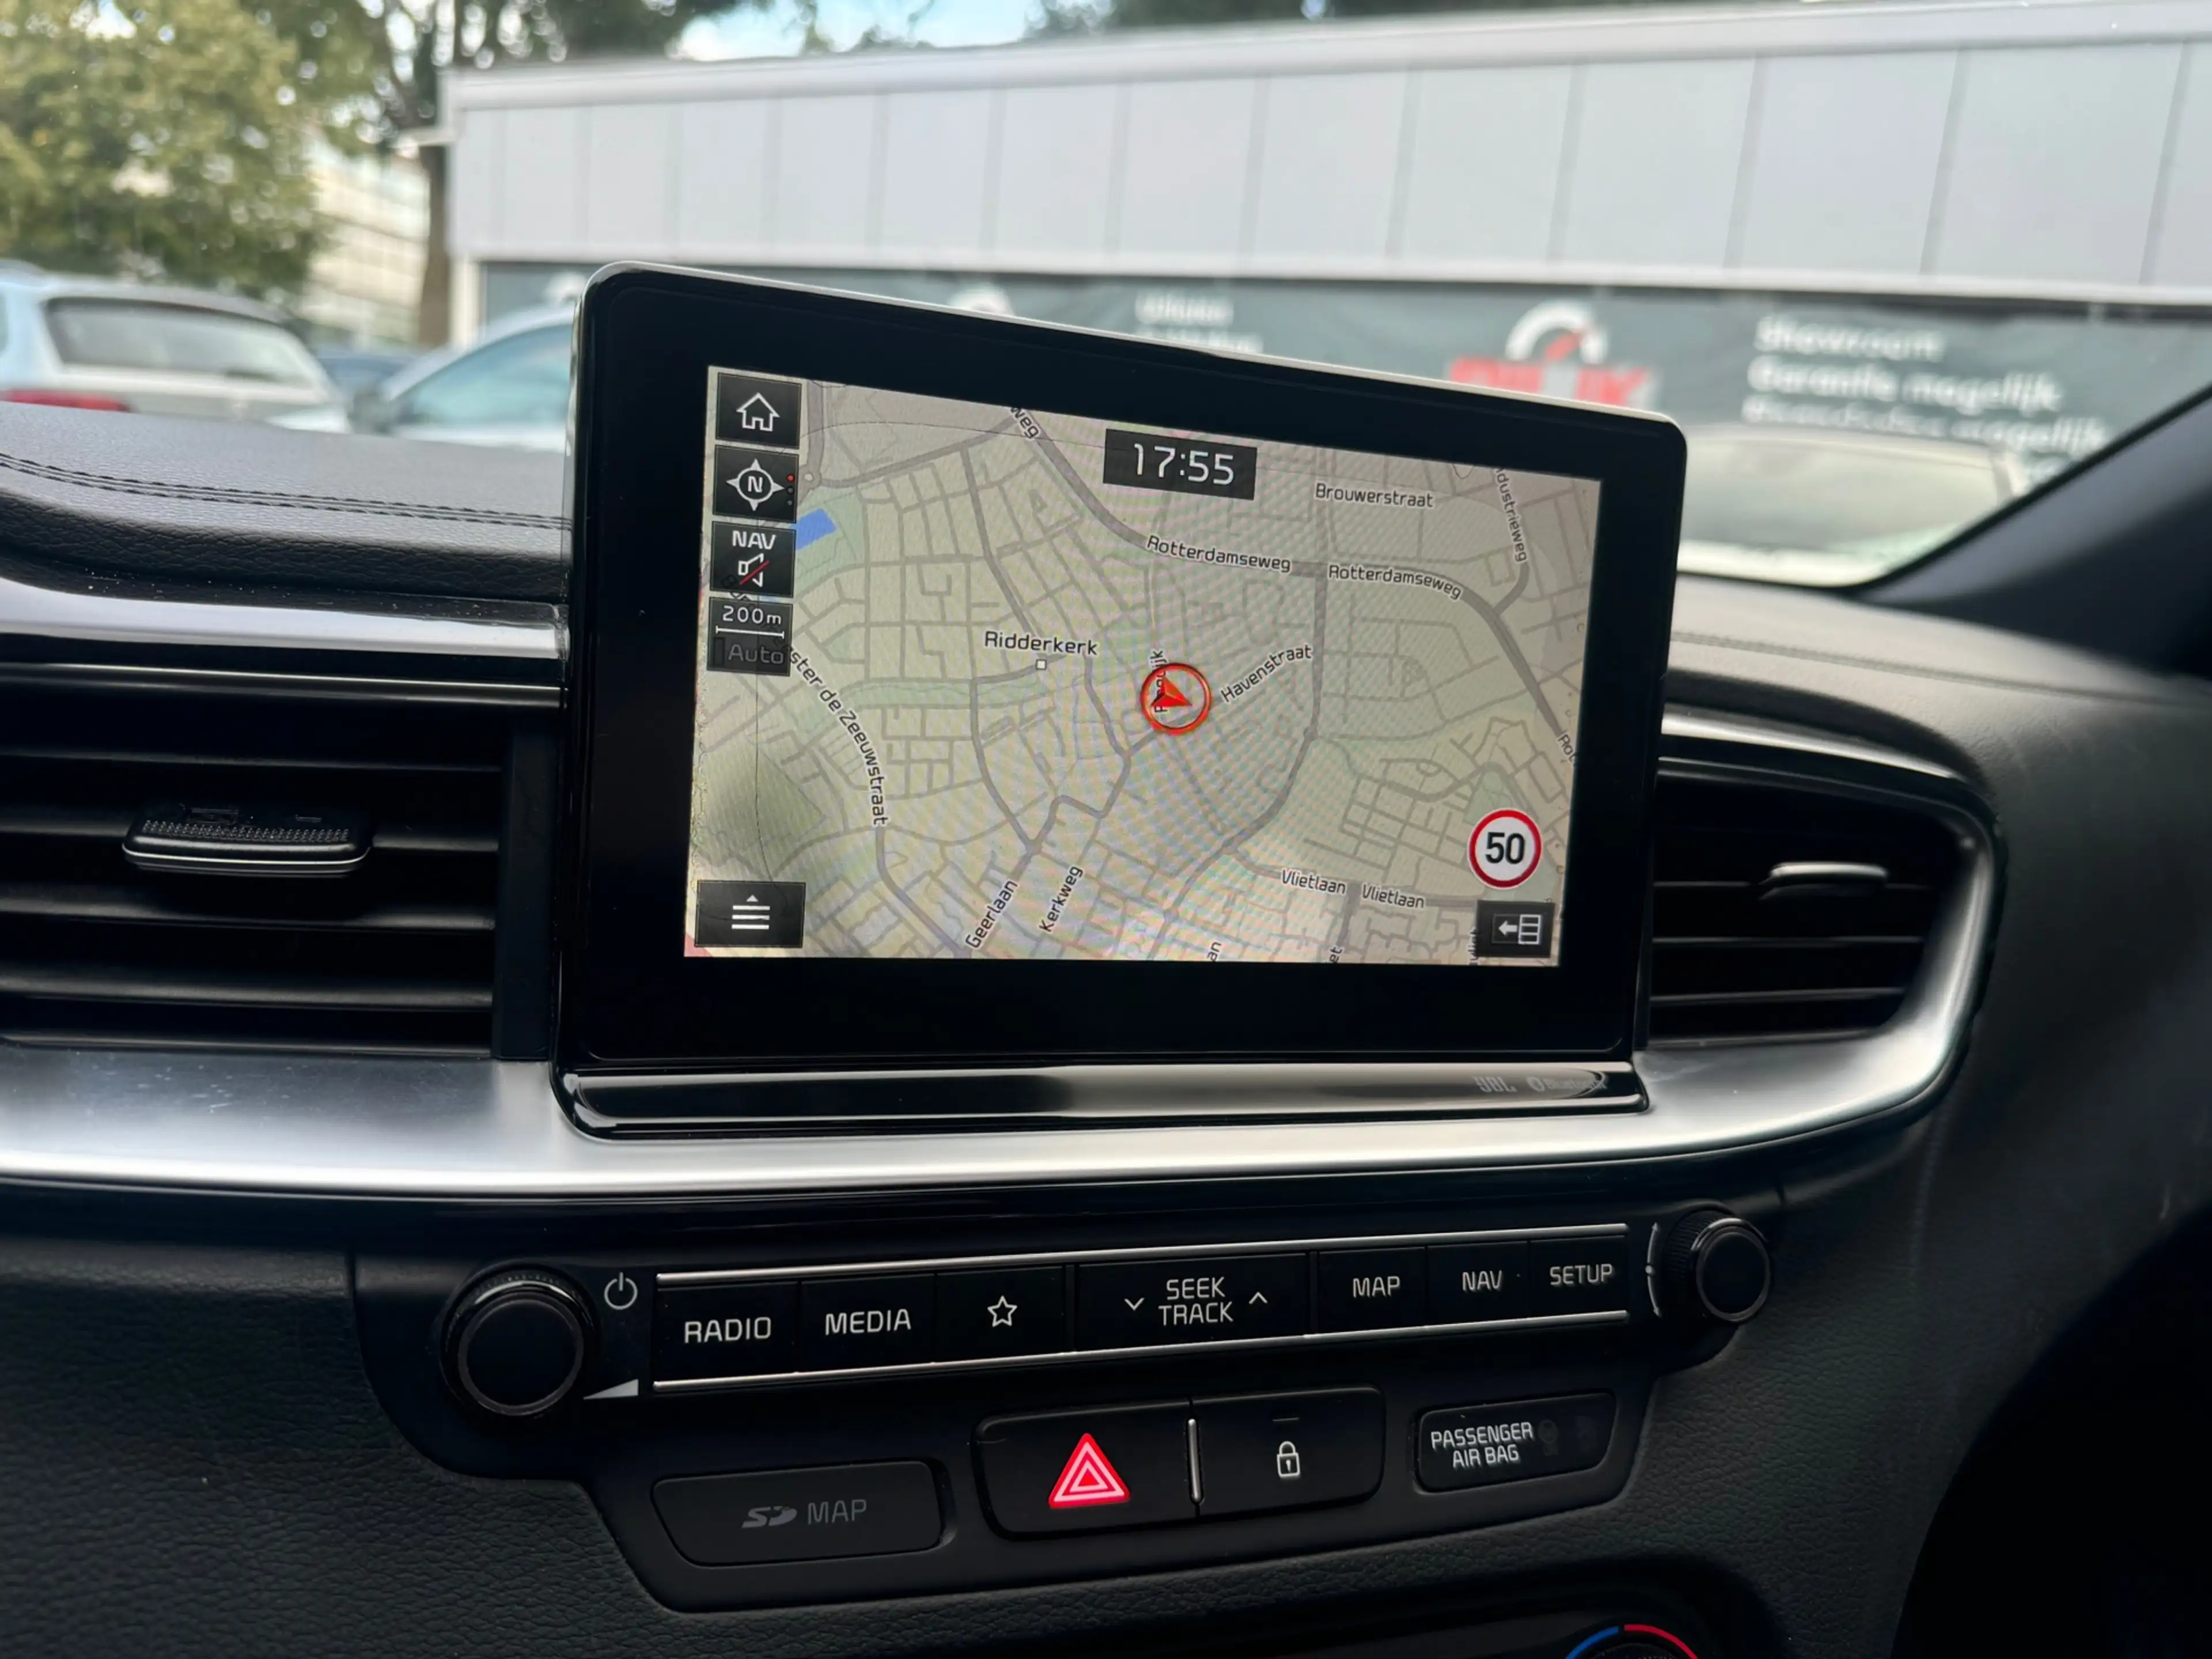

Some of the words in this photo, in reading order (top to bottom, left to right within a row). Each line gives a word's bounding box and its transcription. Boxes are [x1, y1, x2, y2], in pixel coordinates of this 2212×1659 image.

[1133, 442, 1235, 486] 17:55
[748, 475, 763, 493] N
[1316, 483, 1433, 508] Brouwerstraat
[732, 530, 777, 550] NAV
[1147, 535, 1291, 573] Rotterdamseweg
[1328, 565, 1462, 600] Rotterdamseweg
[722, 605, 782, 625] 200m
[728, 643, 784, 664] Auto
[985, 630, 1097, 655] Ridderkerk
[1221, 644, 1312, 703] Havenstraat
[819, 689, 842, 712] de
[839, 710, 889, 825] Zeeuwstraat
[1484, 832, 1526, 865] 50
[1282, 869, 1346, 894] Vlietlaan
[1039, 866, 1084, 932] Kerkweg
[1362, 884, 1425, 908] Vlietlaan
[965, 880, 1018, 948] Geerlaan
[1352, 1275, 1401, 1298] MAP
[1461, 1270, 1502, 1291] NAV
[1550, 1263, 1613, 1286] SETUP
[1165, 1277, 1226, 1300] SEEK
[824, 1308, 912, 1336] MEDIA
[1158, 1301, 1234, 1327] TRACK
[684, 1316, 772, 1344] RADIO
[1430, 1421, 1533, 1450] PASSENGER
[1452, 1447, 1482, 1469] AIR
[1484, 1443, 1520, 1464] BAG
[808, 1498, 867, 1525] MAP
